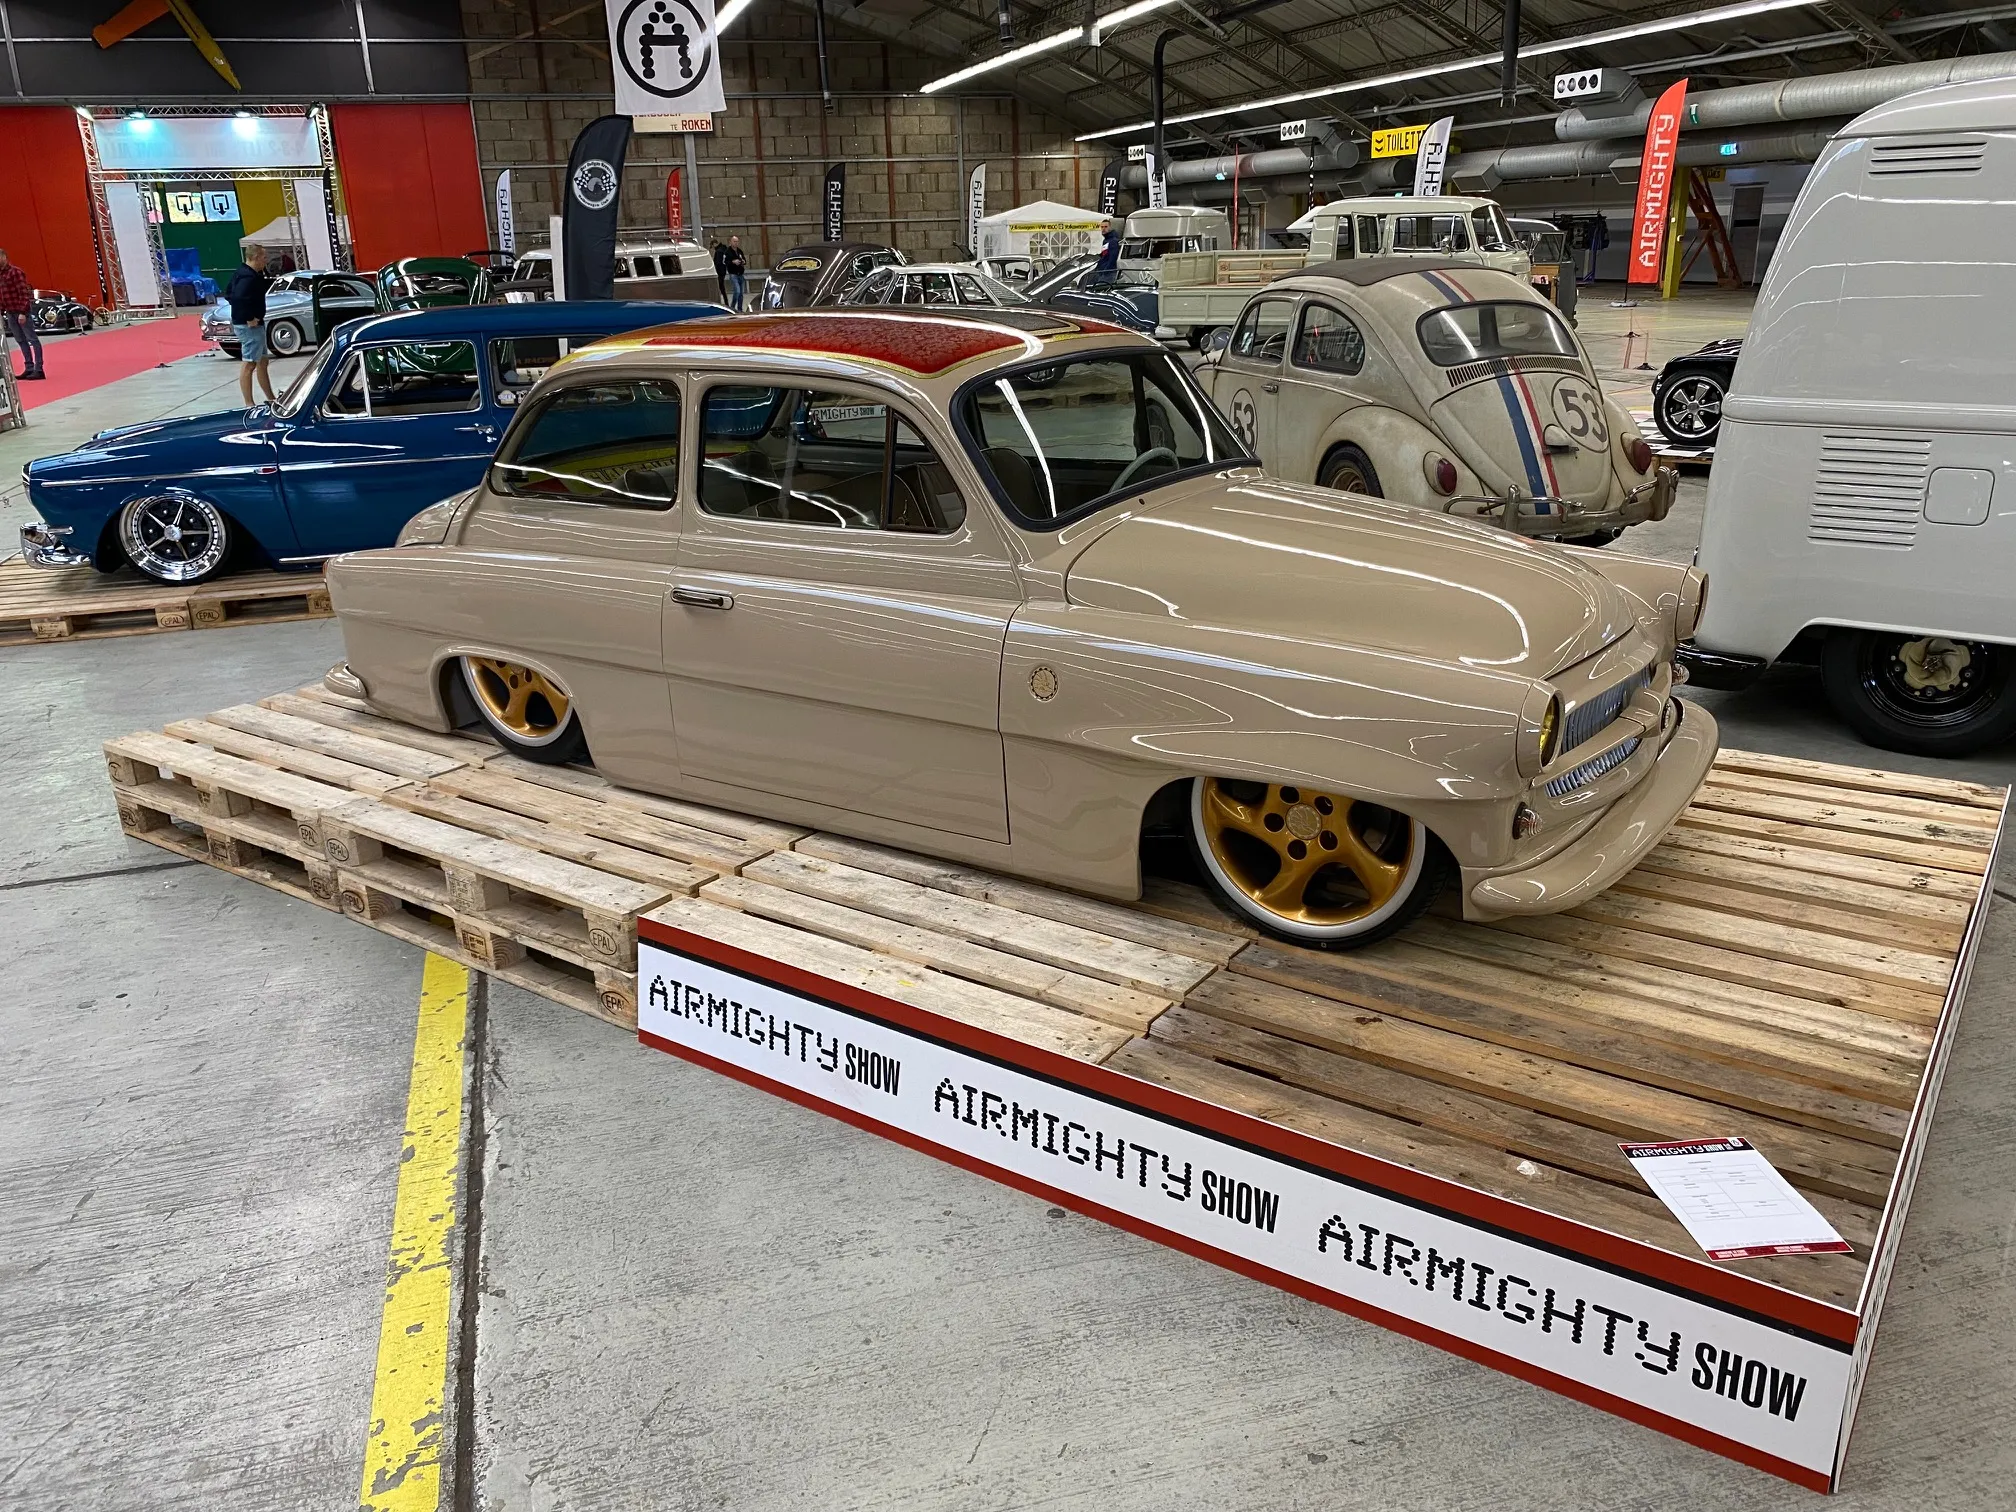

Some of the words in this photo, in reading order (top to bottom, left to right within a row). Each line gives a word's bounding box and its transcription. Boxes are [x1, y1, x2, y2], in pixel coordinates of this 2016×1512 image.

[681, 119, 711, 131] ROKEN
[1639, 114, 1674, 267] AIRMIGHTY
[1234, 402, 1255, 453] 53
[1559, 389, 1607, 443] 53
[200, 612, 216, 620] EPAL
[301, 827, 317, 844] EPAL
[591, 931, 615, 953] EPAL
[649, 975, 839, 1073] AIRMIGHTY
[845, 1042, 901, 1097] SHOW
[934, 1077, 1192, 1202] AIRMIGHTY
[1202, 1169, 1280, 1235] SHOW
[1632, 1145, 1704, 1158] AIRMIGHTY
[1318, 1214, 1682, 1377] AIRMIGHTY
[1691, 1342, 1808, 1423] SHOW
